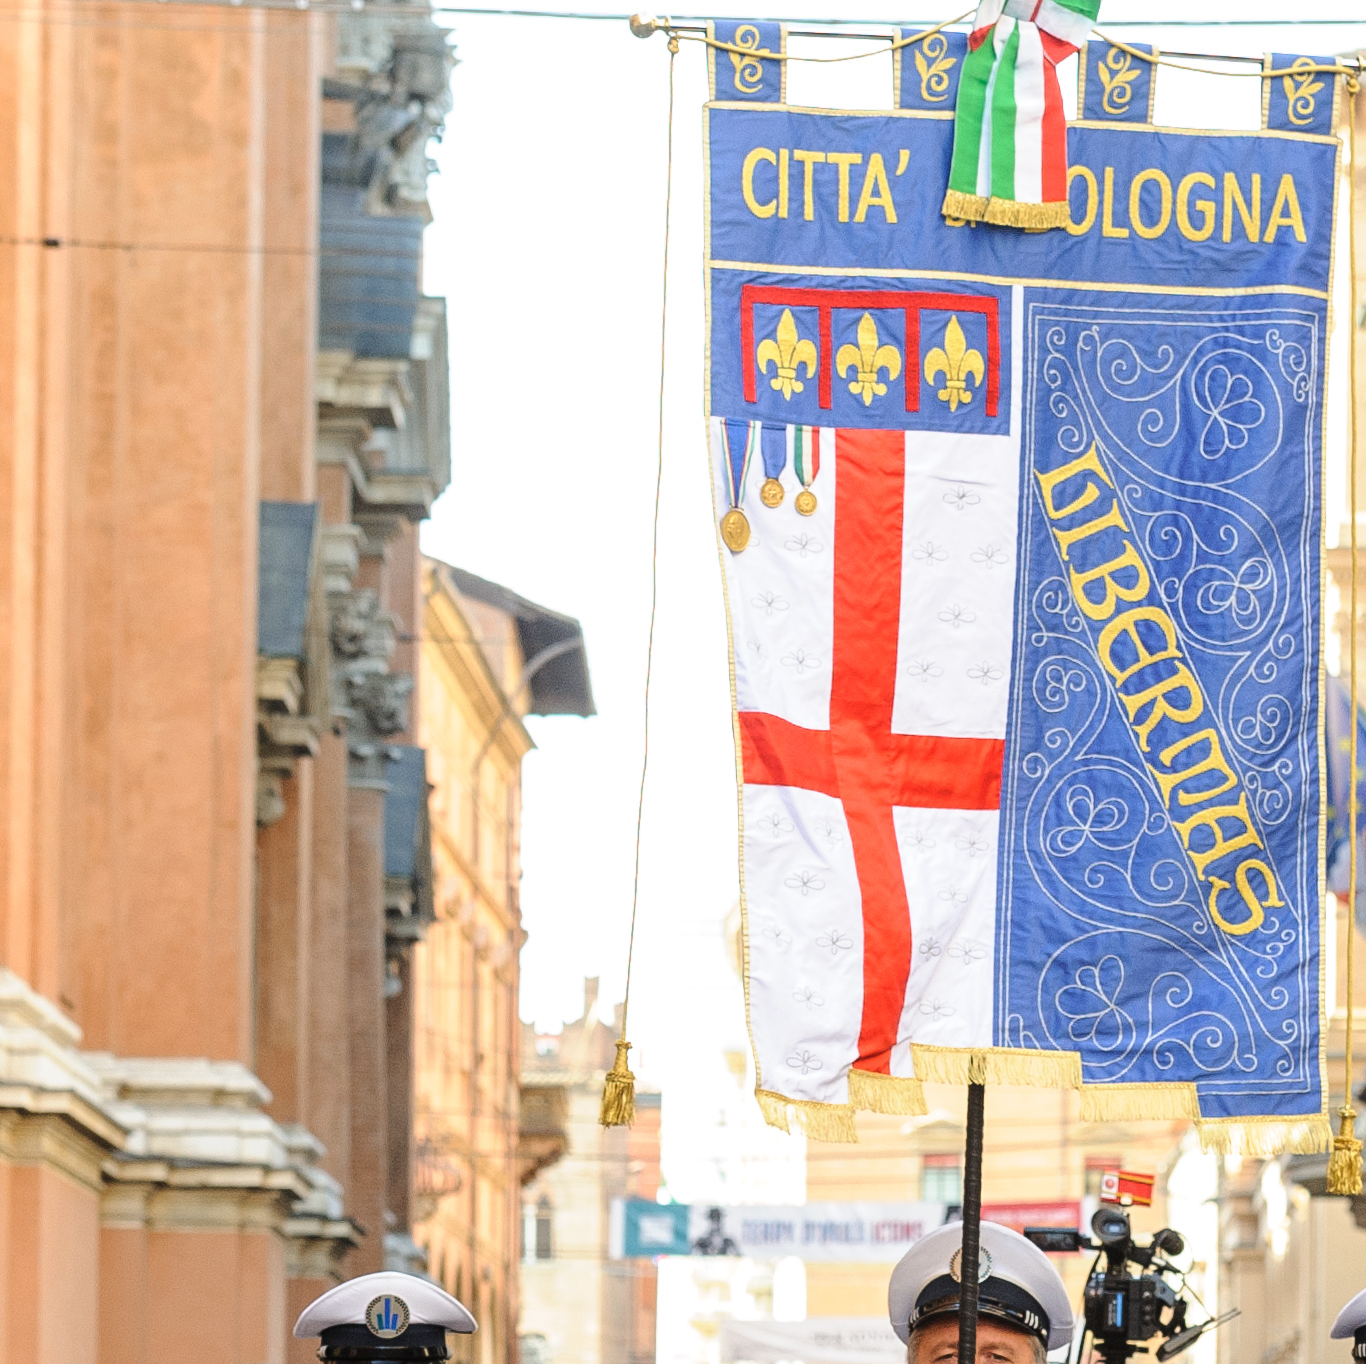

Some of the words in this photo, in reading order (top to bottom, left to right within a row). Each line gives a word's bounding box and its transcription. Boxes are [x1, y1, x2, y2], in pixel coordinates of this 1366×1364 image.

[741, 147, 910, 223] CITTA'
[1025, 165, 1307, 243] OLOGNA
[1034, 441, 1284, 936] LIBERTAS
